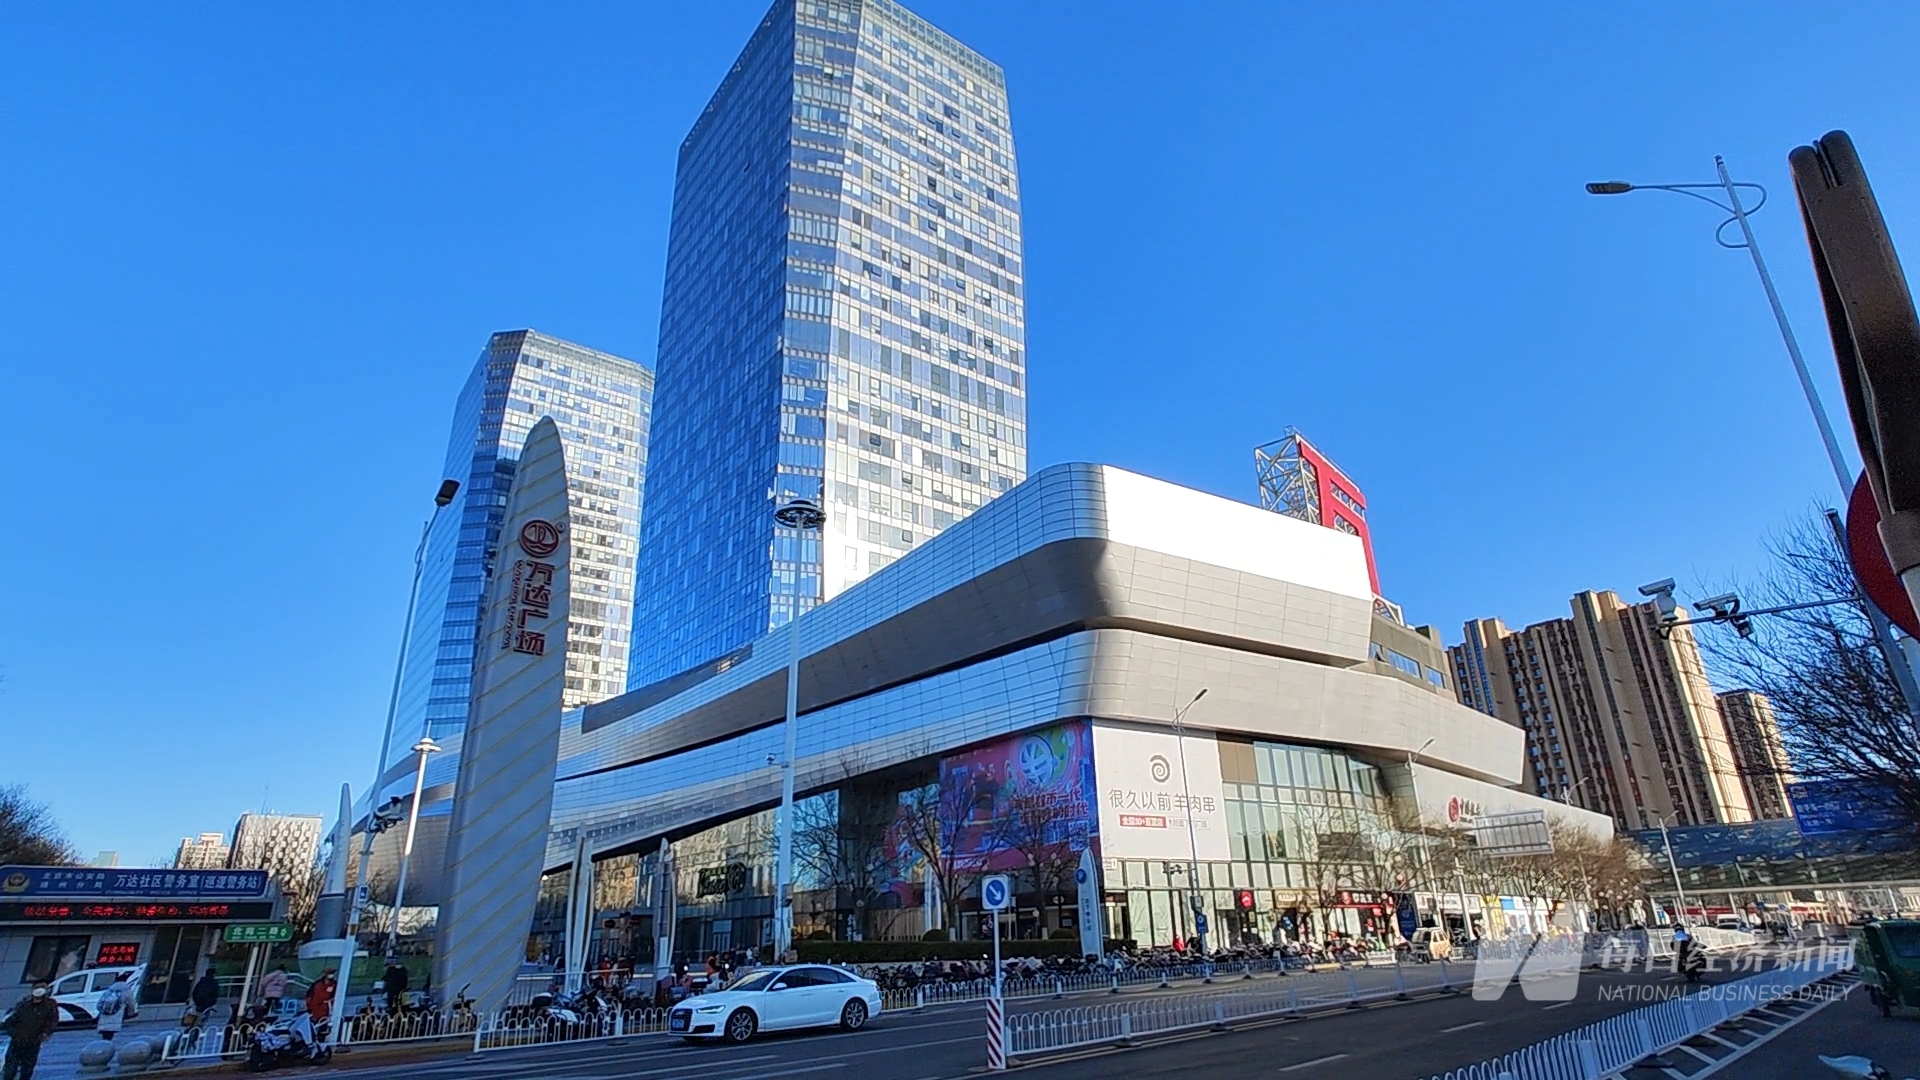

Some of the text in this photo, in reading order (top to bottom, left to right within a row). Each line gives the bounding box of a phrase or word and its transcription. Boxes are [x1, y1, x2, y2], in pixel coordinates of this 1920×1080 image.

[513, 561, 555, 656] 万达广场
[1108, 788, 1216, 814] 很久以前羊肉串
